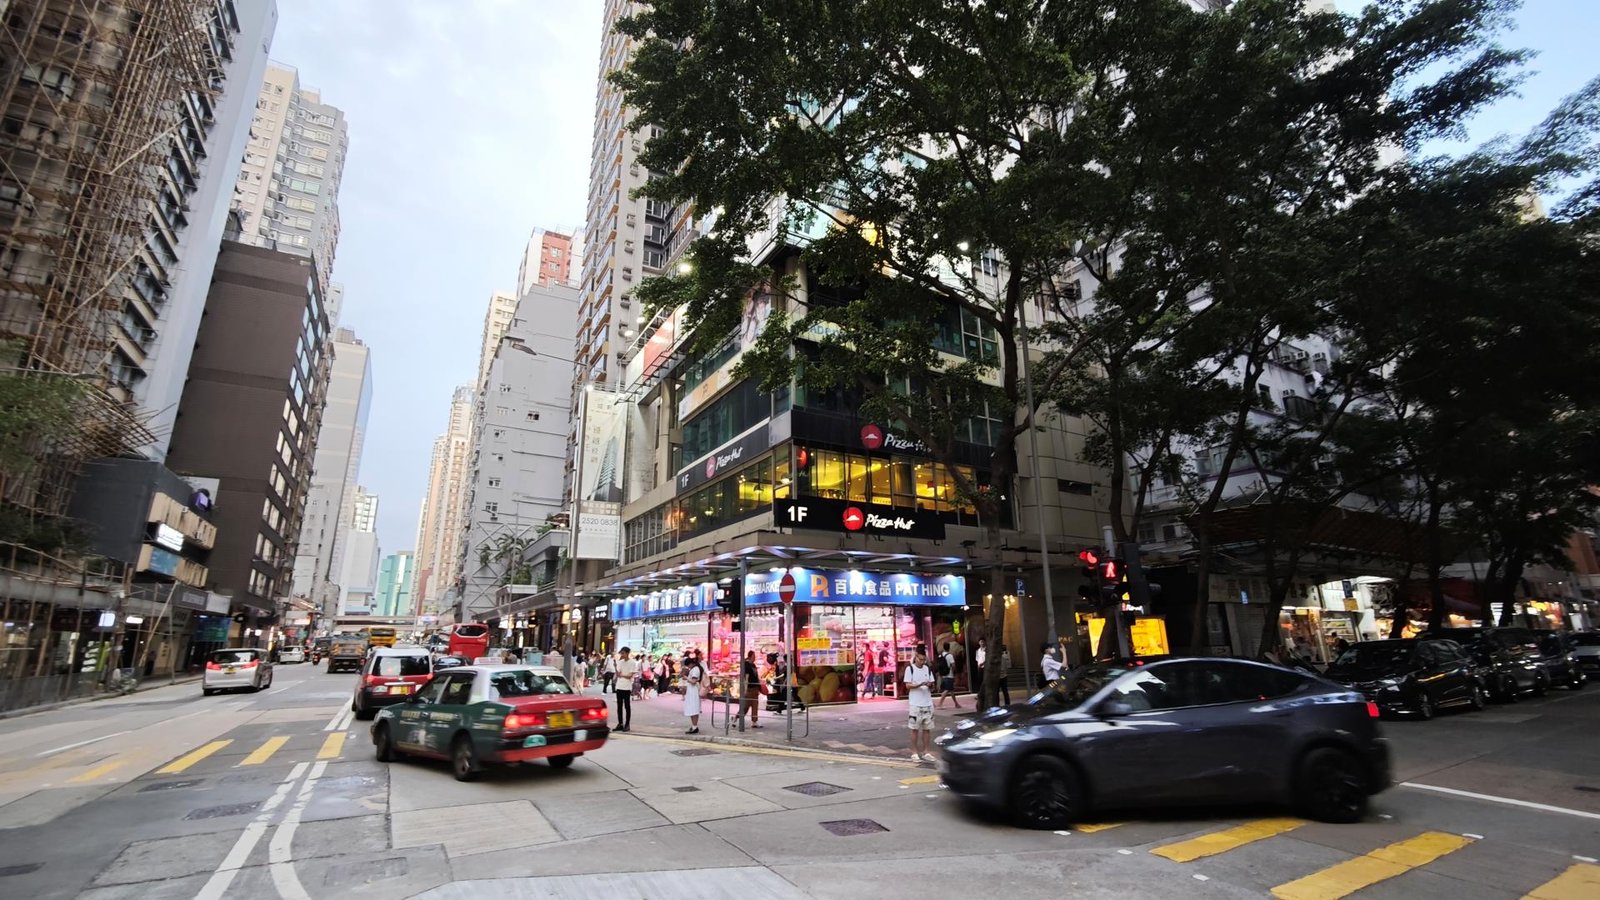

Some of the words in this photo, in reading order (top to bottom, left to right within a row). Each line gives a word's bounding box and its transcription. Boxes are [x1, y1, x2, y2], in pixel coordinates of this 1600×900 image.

[884, 433, 915, 450] Pizza
[715, 455, 731, 471] Pizza
[730, 446, 744, 462] Hut
[681, 474, 689, 488] 1F
[581, 517, 599, 525] 2520
[787, 505, 808, 522] 1F
[864, 513, 894, 529] Pizza
[893, 516, 916, 530] Hut
[895, 582, 920, 597] PAT
[921, 583, 950, 597] HING
